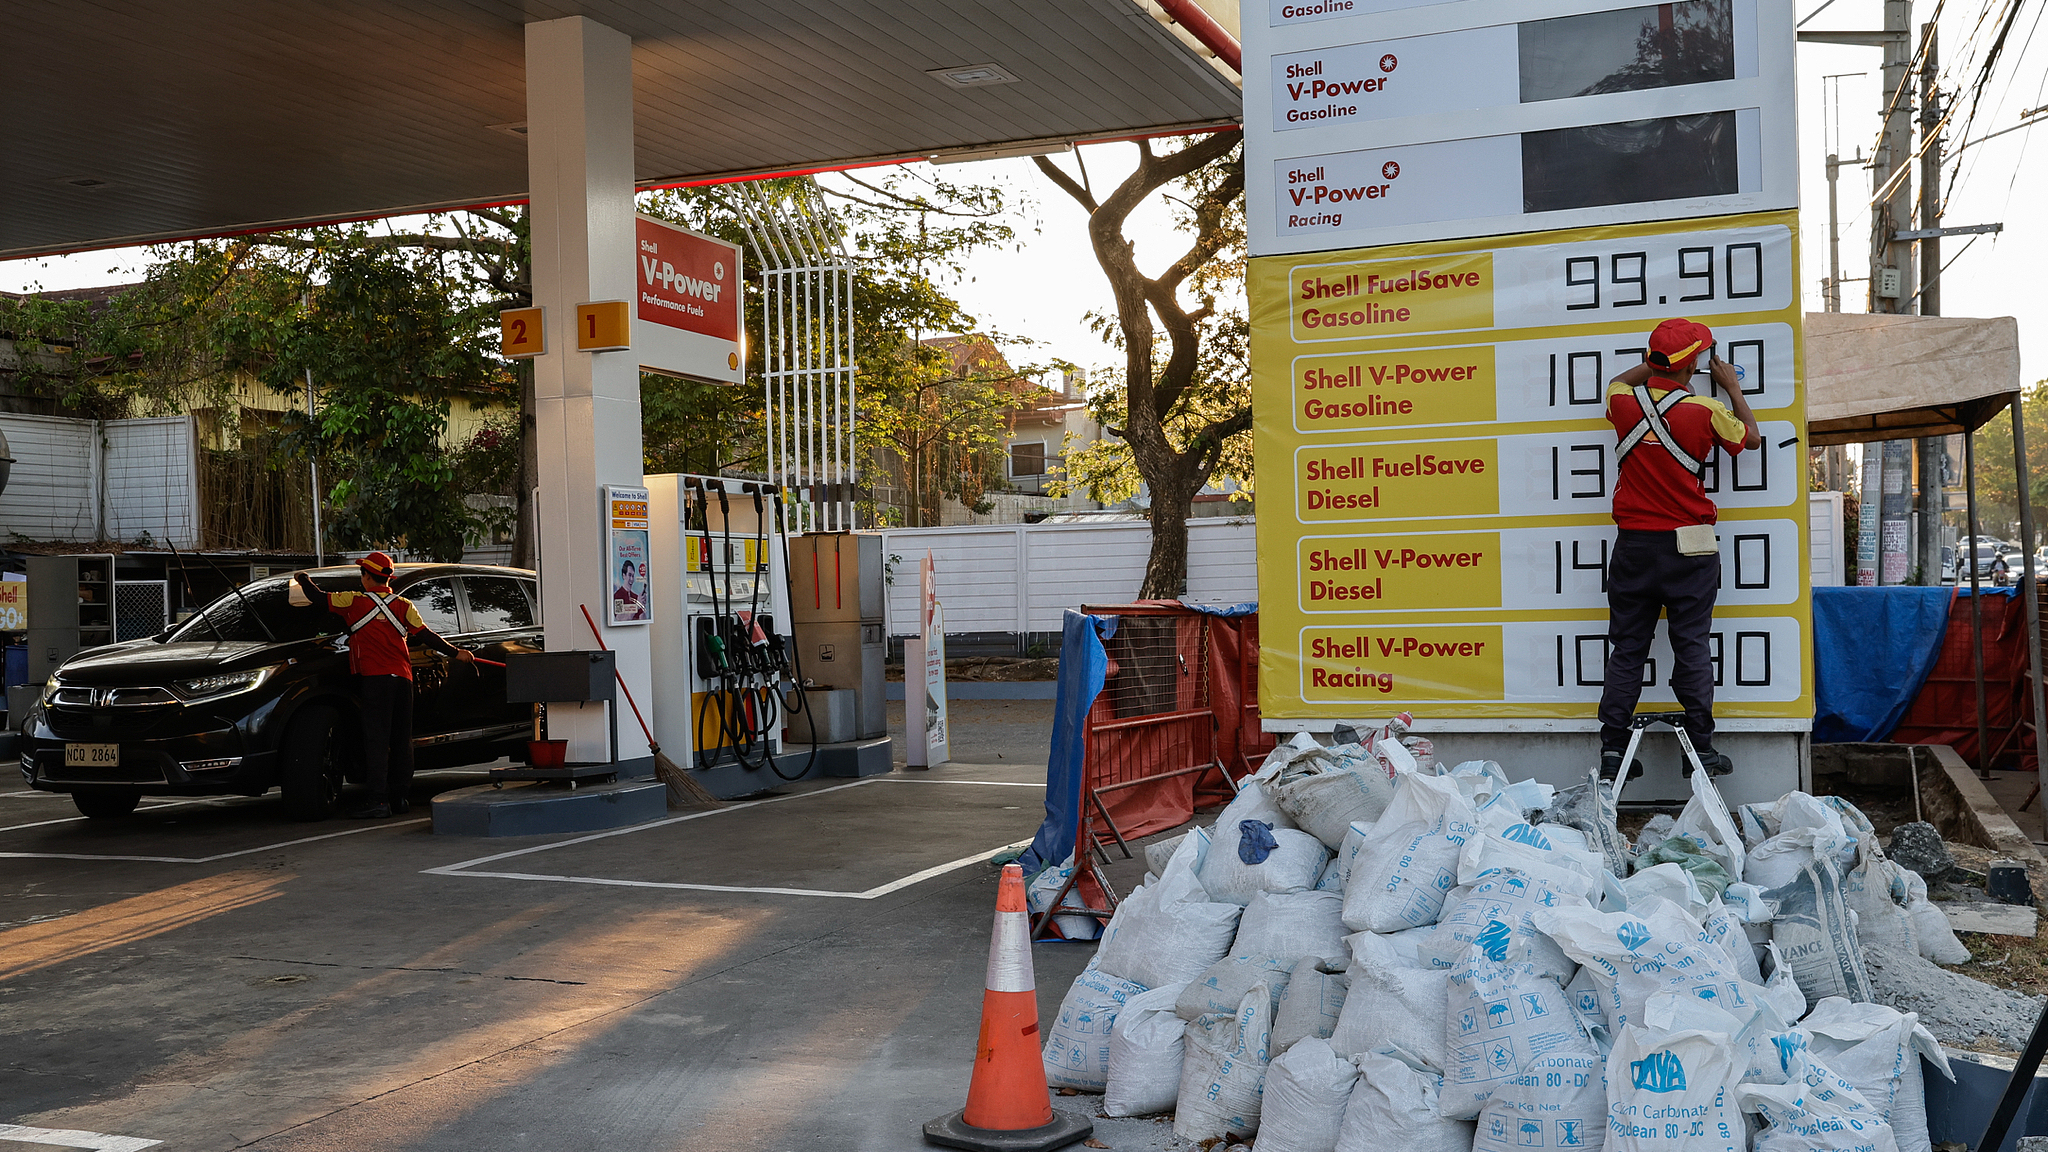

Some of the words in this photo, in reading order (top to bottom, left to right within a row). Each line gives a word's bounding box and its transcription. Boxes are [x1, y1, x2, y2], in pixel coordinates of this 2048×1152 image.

[1282, 0, 1354, 19] Gasoline
[1286, 61, 1323, 79] Shell
[1287, 74, 1388, 101] V-Power
[1286, 102, 1358, 123] Gasoline
[1288, 167, 1325, 184] Shell
[1289, 181, 1391, 207] V-Power
[1288, 211, 1343, 229] Racing
[641, 240, 658, 254] Shell
[641, 255, 721, 303] V-Power
[1301, 274, 1359, 300] Shell
[1367, 268, 1480, 295] FuelSave
[1566, 242, 1764, 311] 99.90
[642, 292, 686, 313] Performance
[687, 304, 704, 317] Fuels
[587, 315, 596, 339] 1
[1302, 305, 1411, 329] Gasoline
[511, 319, 527, 345] 2
[1303, 366, 1361, 390] Shell
[1368, 364, 1477, 386] V-Power
[1304, 394, 1413, 419] Gasoline
[1306, 457, 1364, 481] Shell
[1373, 454, 1485, 478] FuelSave
[612, 491, 630, 499] Welcome
[1307, 486, 1379, 510] Diesel
[1309, 549, 1367, 571] Shell
[1374, 549, 1483, 569] V-Power
[0, 586, 17, 603] hell
[1310, 578, 1382, 600] Diesel
[1311, 636, 1369, 658] Shell
[1376, 638, 1485, 657] V-Power
[1312, 666, 1393, 693] Racing
[67, 745, 85, 762] NCQ
[91, 744, 116, 761] 2864
[1400, 855, 1412, 868] 80
[1112, 990, 1126, 1003] 80
[1221, 1060, 1232, 1075] 80
[1546, 1073, 1561, 1087] 80
[1574, 1073, 1590, 1088] DC
[1207, 1083, 1221, 1101] DC
[1502, 1100, 1514, 1109] 25
[1518, 1102, 1534, 1112] Kg
[1539, 1103, 1561, 1111] Net
[1665, 1123, 1678, 1139] 80
[1690, 1121, 1704, 1137] DC
[1717, 1122, 1731, 1139] 80
